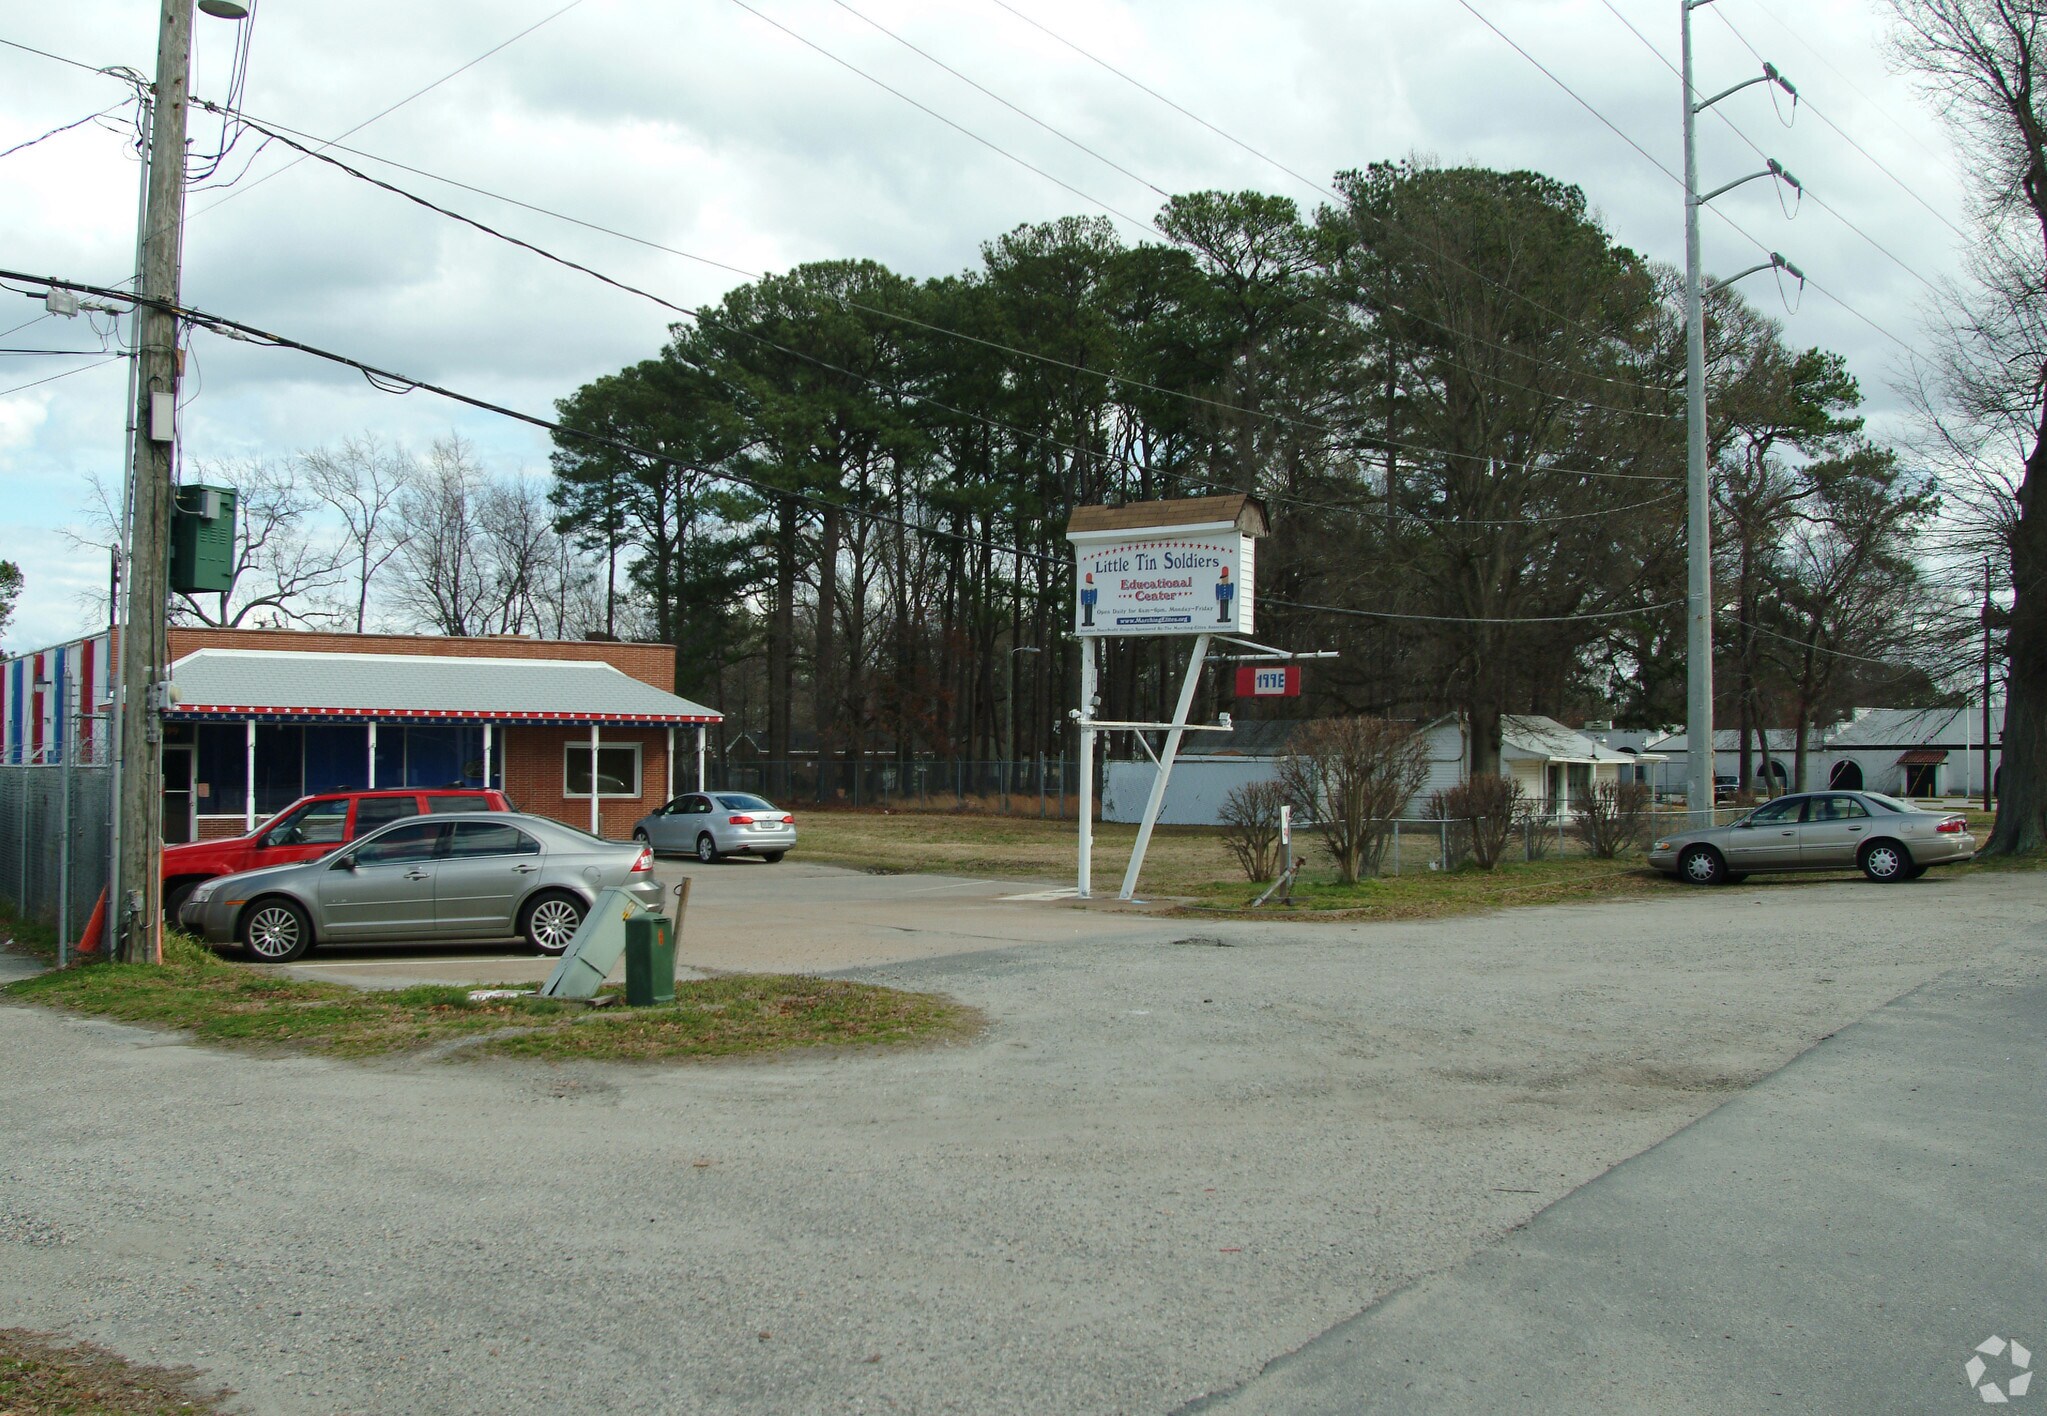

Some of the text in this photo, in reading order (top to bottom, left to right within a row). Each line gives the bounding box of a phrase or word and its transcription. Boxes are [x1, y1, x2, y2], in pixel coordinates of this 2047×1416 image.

[1095, 551, 1220, 573] Little Tin Soldiers
[1120, 577, 1192, 591] Educational
[1135, 590, 1177, 602] Center
[1257, 673, 1284, 688] 199E
